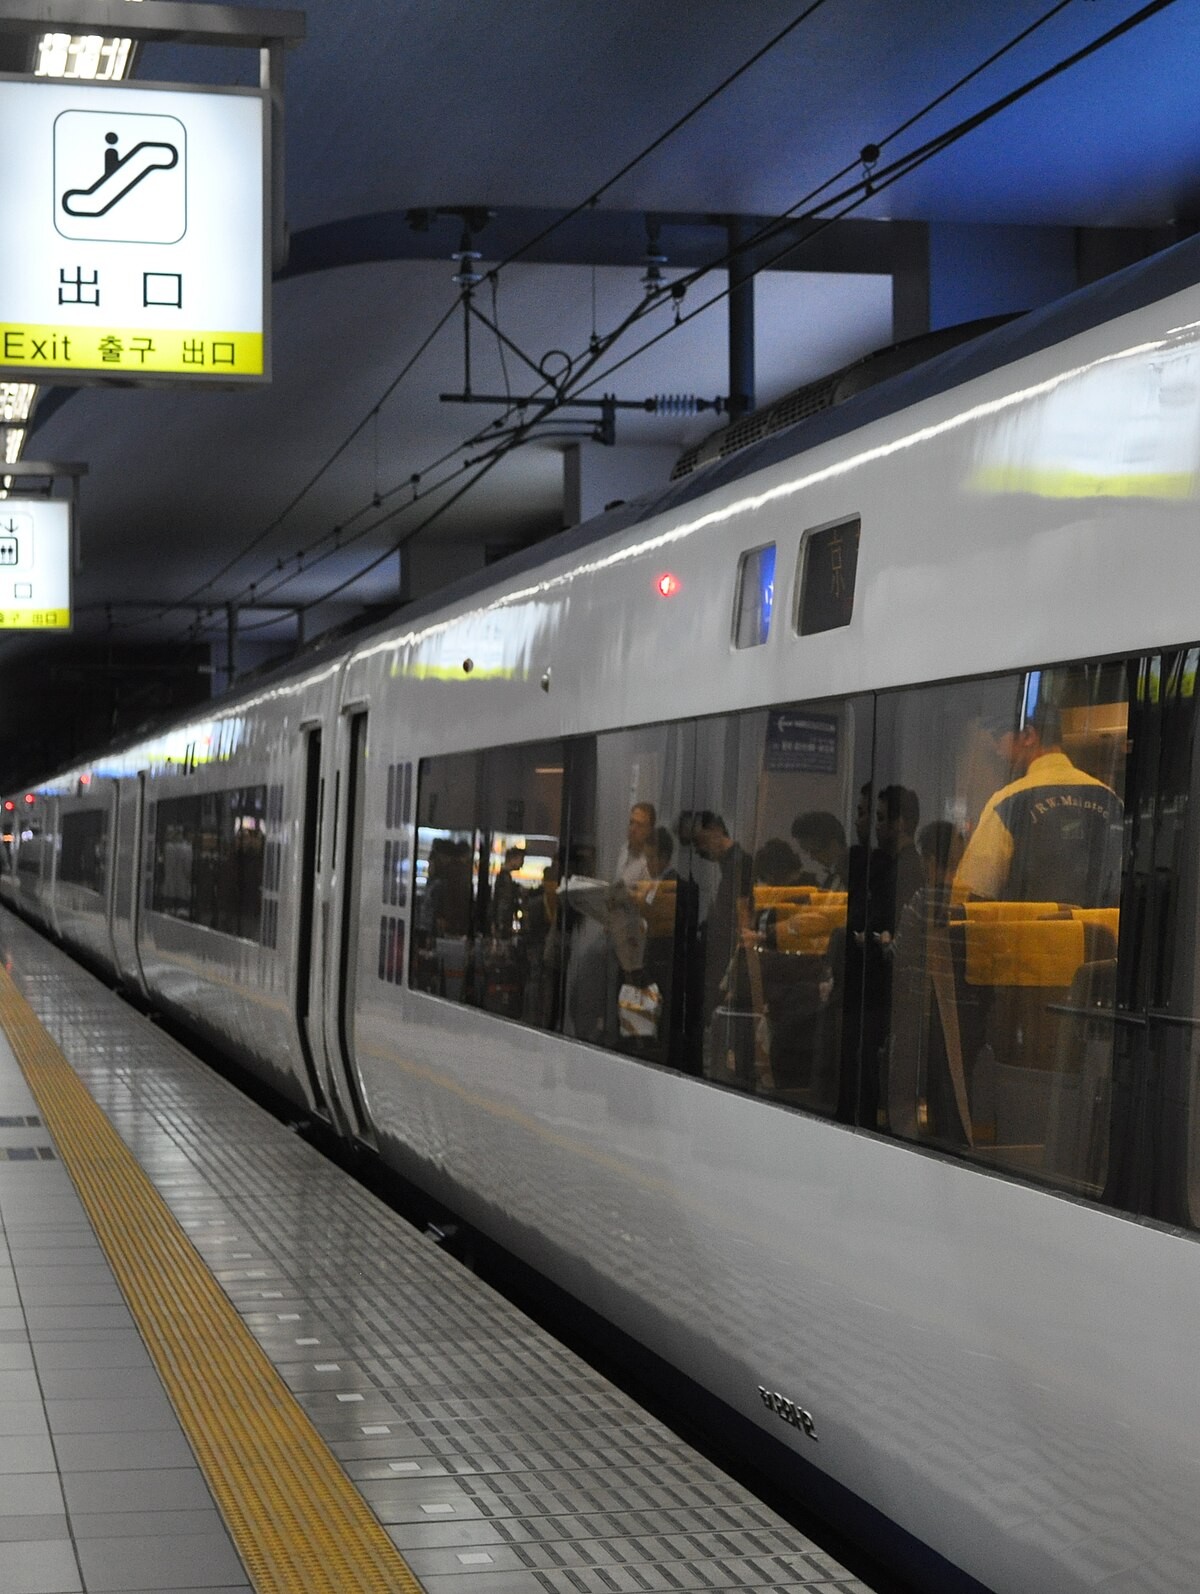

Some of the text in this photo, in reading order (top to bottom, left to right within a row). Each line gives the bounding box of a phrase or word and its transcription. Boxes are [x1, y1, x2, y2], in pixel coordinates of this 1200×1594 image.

[4, 331, 235, 366] Exit 출구 出口
